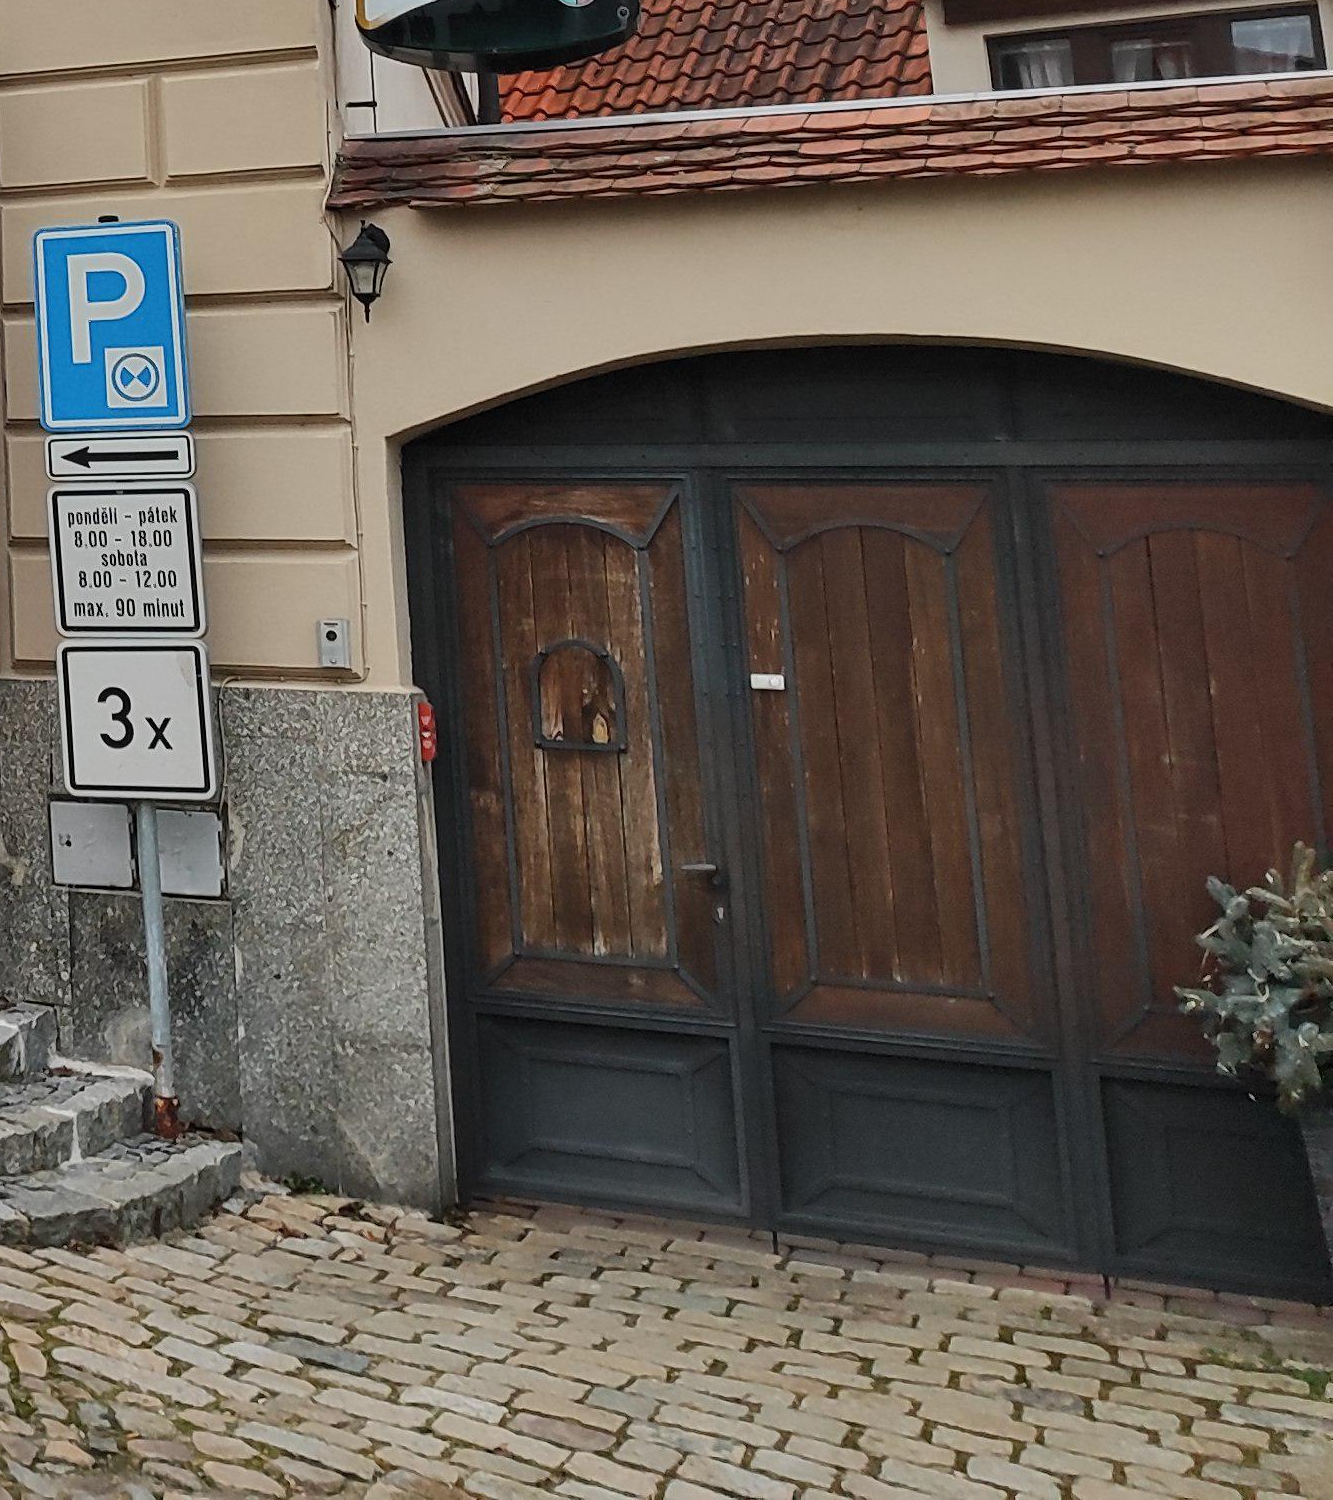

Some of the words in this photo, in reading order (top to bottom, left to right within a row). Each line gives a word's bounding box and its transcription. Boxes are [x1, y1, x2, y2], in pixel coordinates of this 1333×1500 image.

[66, 252, 146, 364] P
[138, 506, 178, 527] pátek
[73, 530, 108, 548] 8.00
[131, 529, 173, 547] 18.00
[100, 550, 148, 567] sobota
[78, 571, 112, 588] 8.00
[135, 570, 177, 588] 12.00
[73, 600, 109, 618] max.
[116, 598, 136, 617] 90
[143, 599, 185, 618] minut
